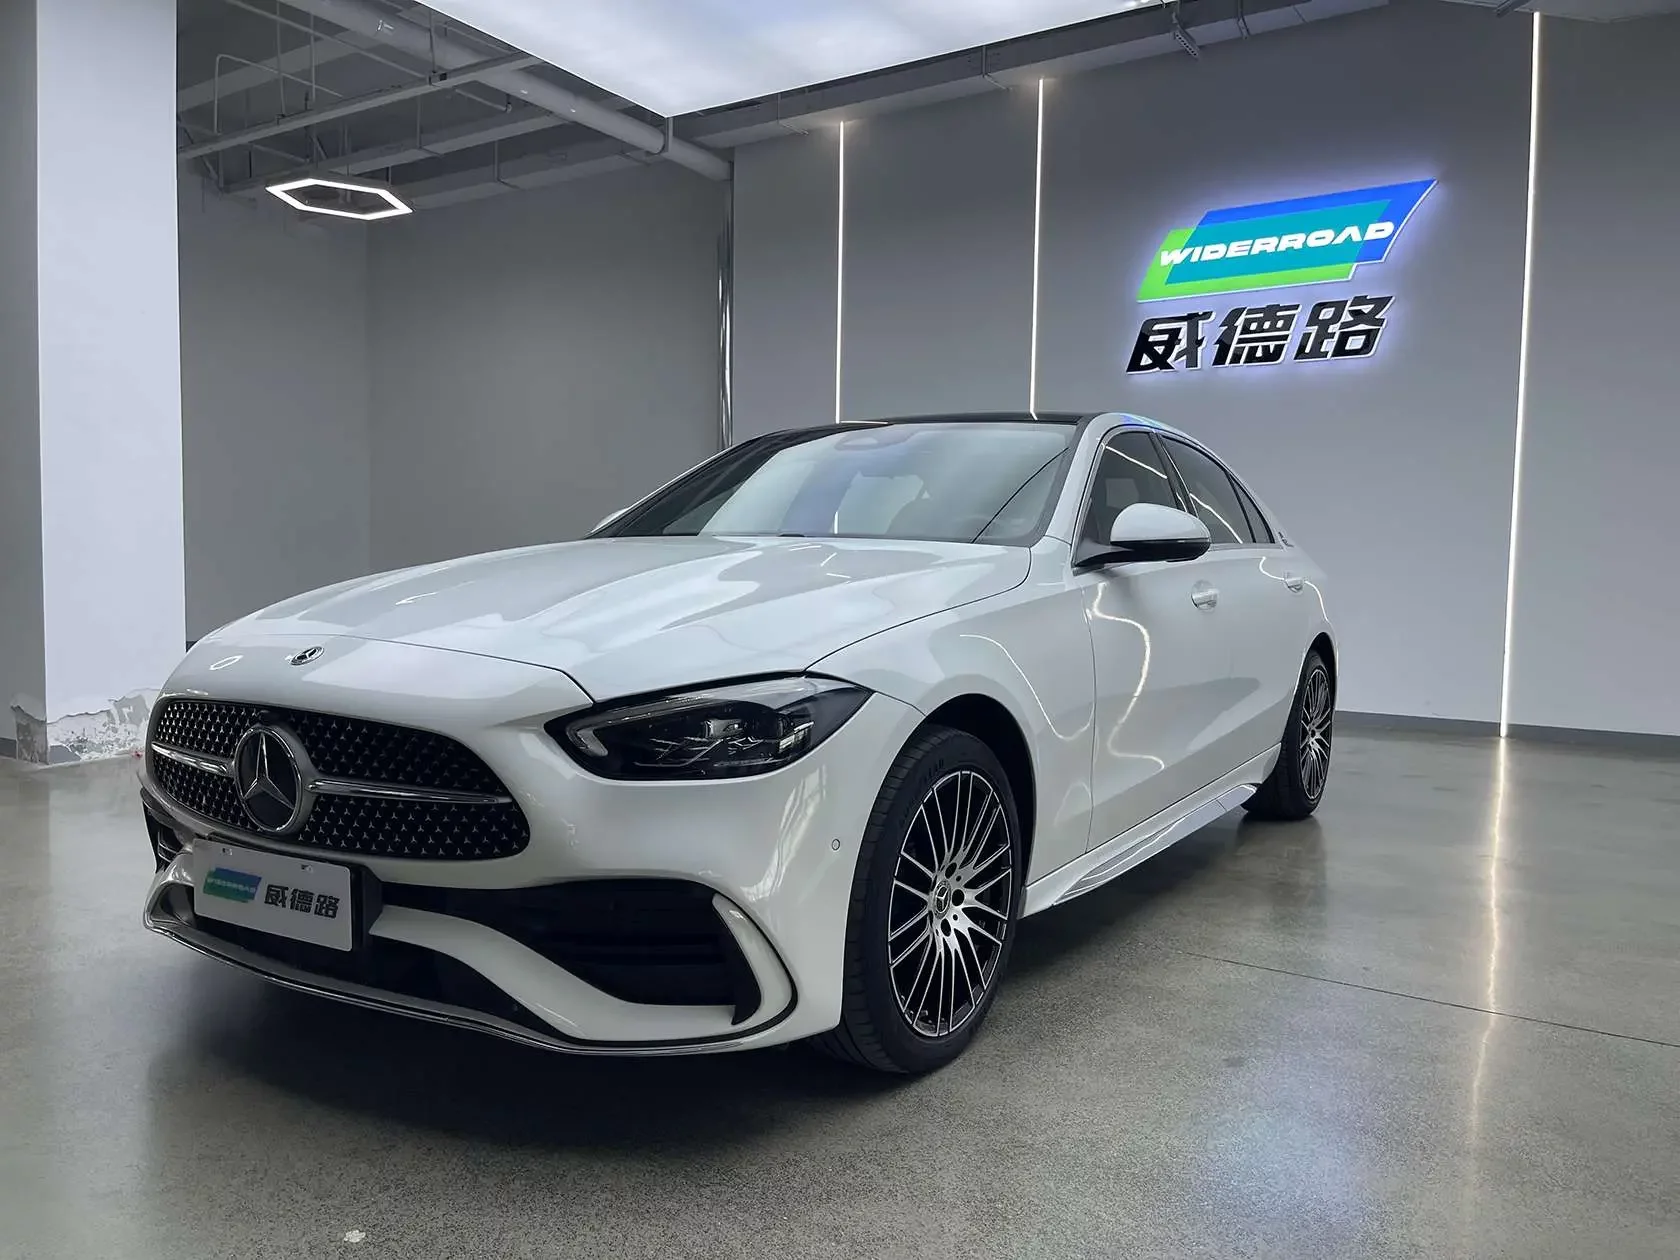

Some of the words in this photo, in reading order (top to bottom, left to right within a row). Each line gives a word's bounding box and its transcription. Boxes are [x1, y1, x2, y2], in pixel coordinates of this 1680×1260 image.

[1160, 221, 1395, 266] WIDERROAD
[1125, 294, 1395, 374] 威德路
[264, 883, 341, 919] 威德路
